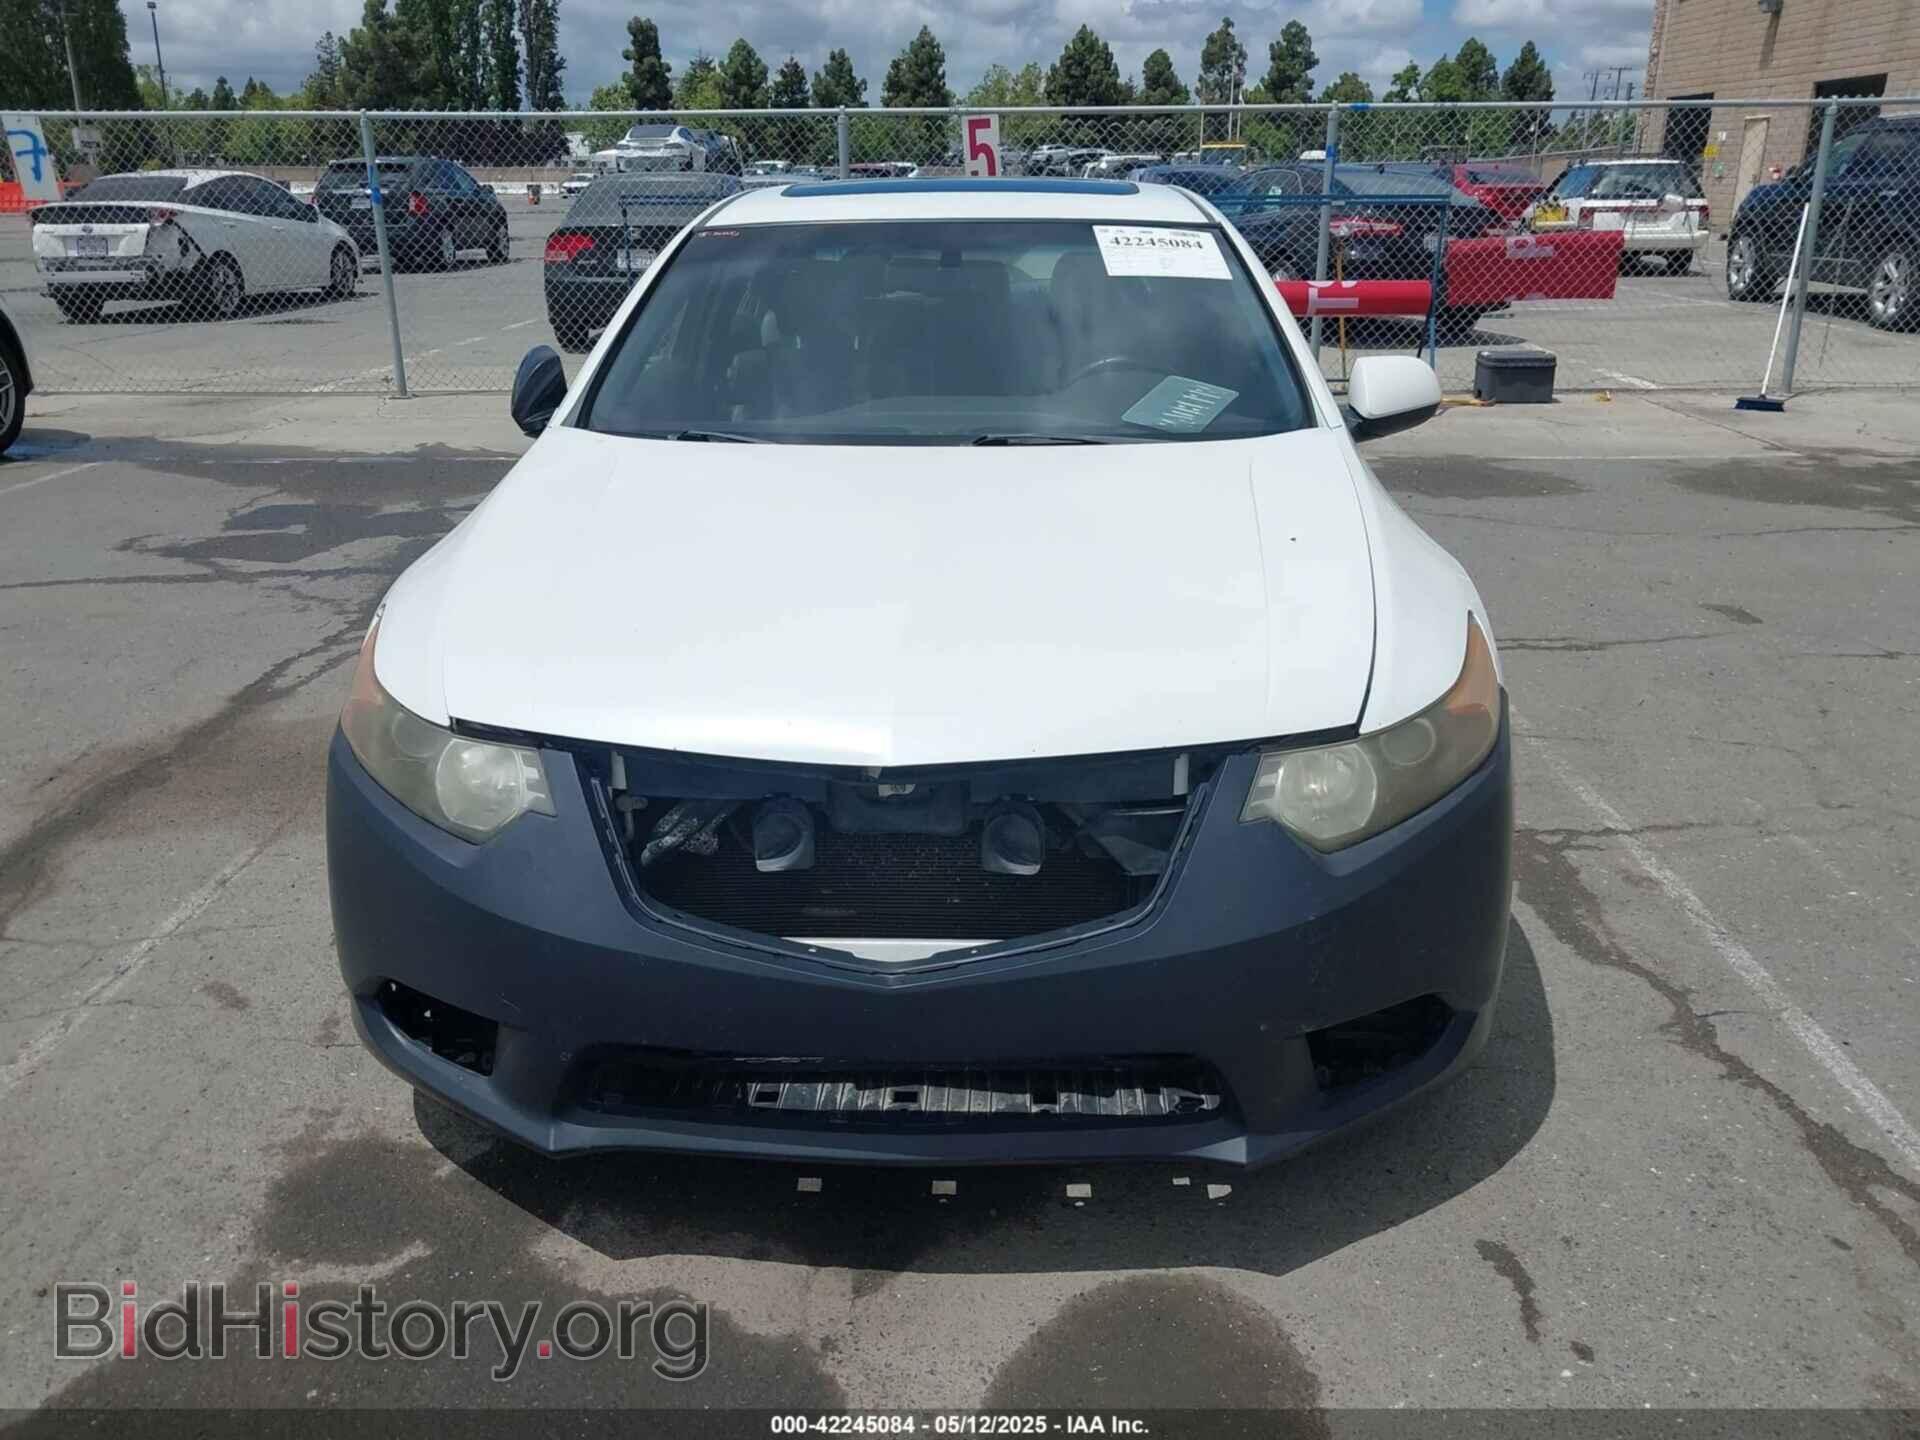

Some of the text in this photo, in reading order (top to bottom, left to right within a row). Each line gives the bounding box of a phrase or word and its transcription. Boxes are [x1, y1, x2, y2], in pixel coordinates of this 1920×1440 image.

[6, 130, 47, 182] 7
[968, 118, 996, 176] 5
[1109, 236, 1204, 250] 42245084
